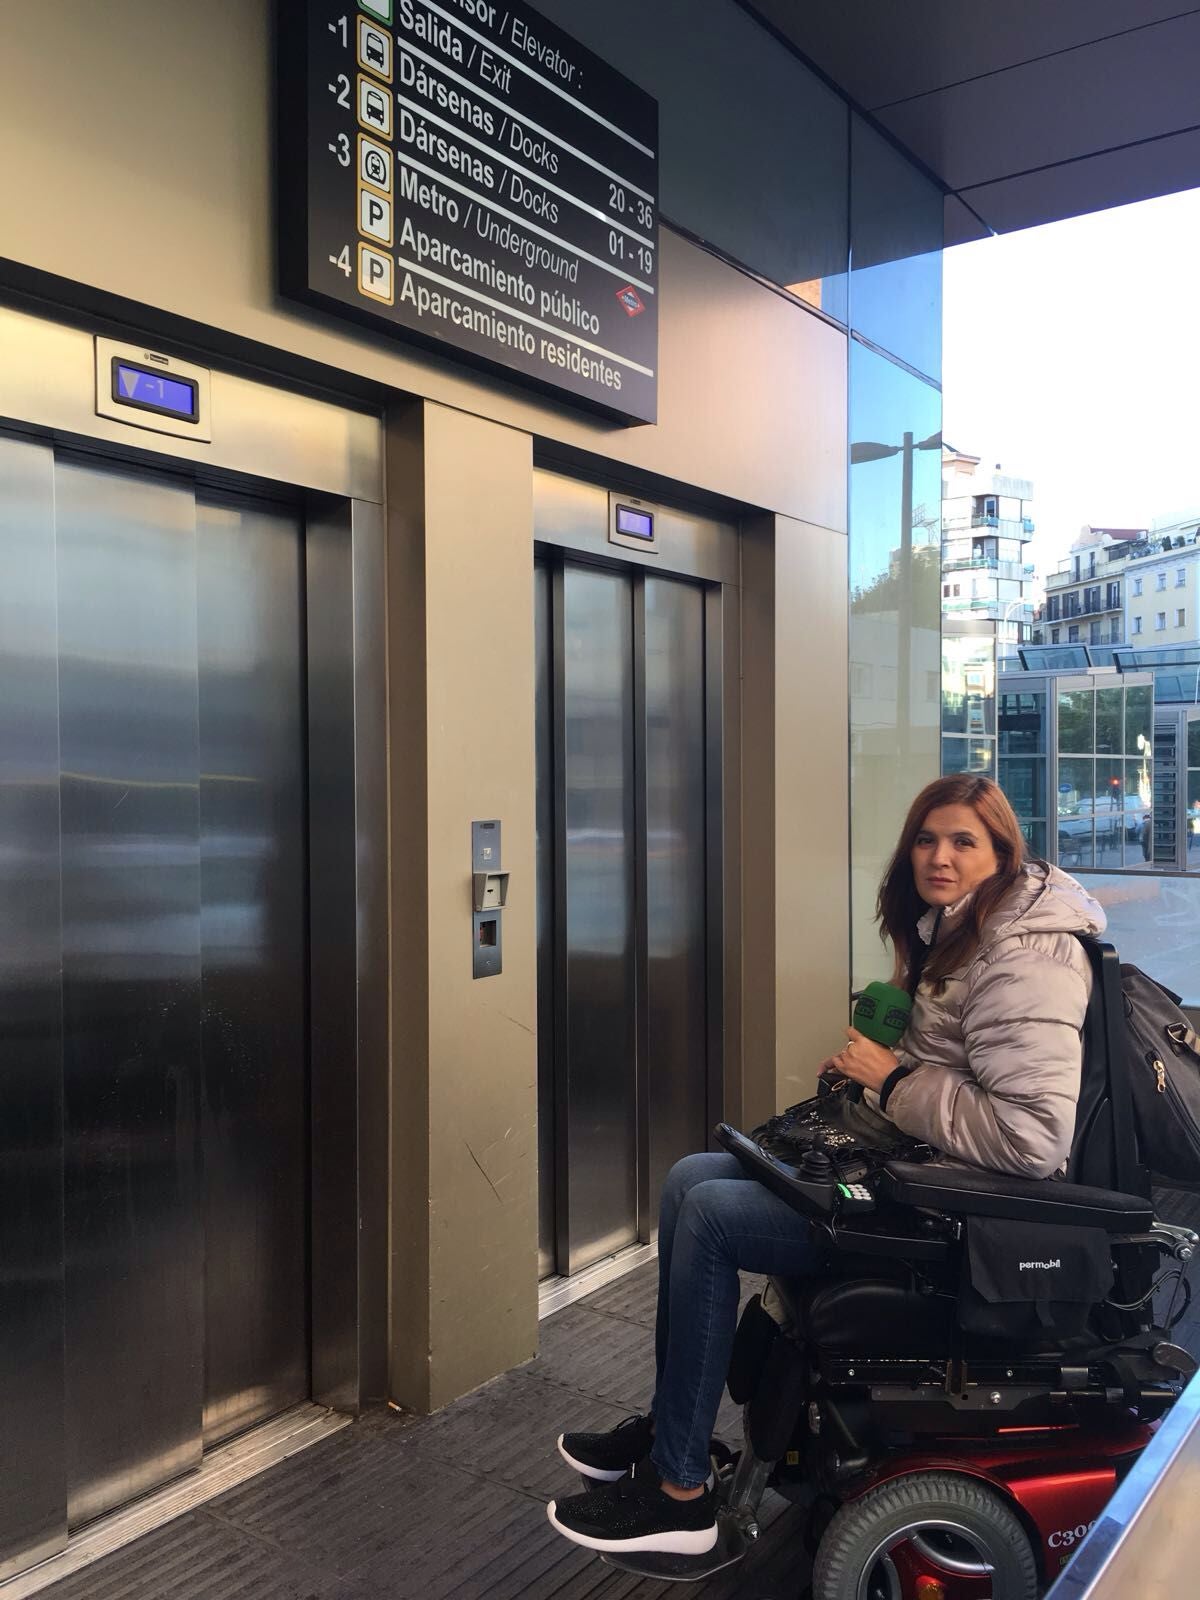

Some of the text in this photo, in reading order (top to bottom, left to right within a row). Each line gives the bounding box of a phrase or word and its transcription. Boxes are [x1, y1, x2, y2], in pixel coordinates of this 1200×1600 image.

[400, 0, 511, 94] Salida / Exit
[500, 12, 509, 35] /
[511, 18, 575, 82] Elevator
[328, 15, 348, 48] -1
[400, 52, 494, 136] Dársenas
[498, 117, 508, 141] /
[510, 122, 559, 174] Docks
[609, 183, 625, 213] 20
[637, 200, 653, 229] 36
[328, 73, 351, 109] -2
[400, 109, 495, 189] Dársenas
[498, 169, 508, 193] /
[510, 174, 559, 224] Docks
[609, 230, 624, 260] 01
[637, 247, 653, 275] 19
[328, 133, 579, 284] -3 Metro / Underground
[369, 199, 600, 335] P Aparcamiento público
[328, 244, 622, 390] -4 P Aparcamiento residentes
[1019, 1259, 1061, 1271] permobil
